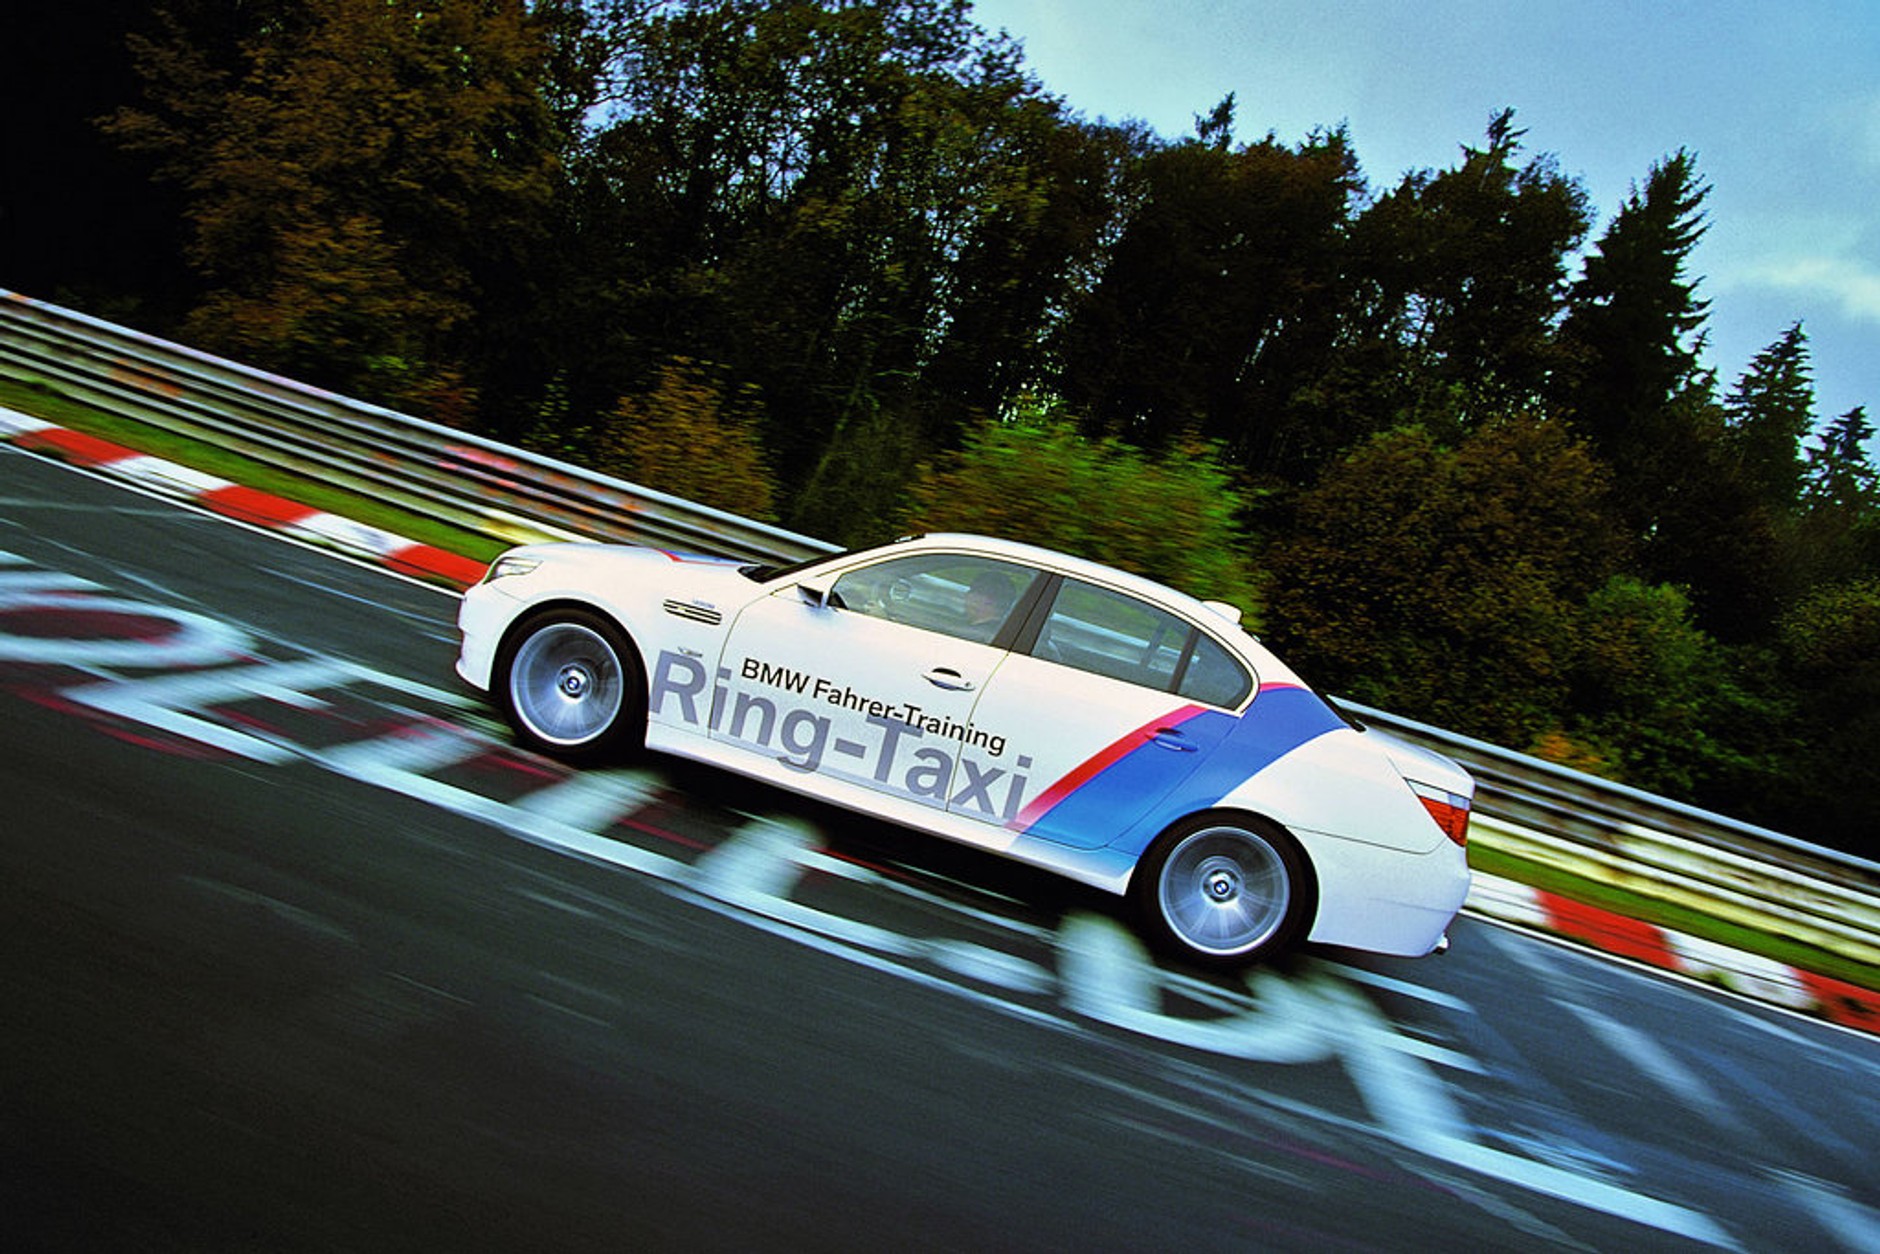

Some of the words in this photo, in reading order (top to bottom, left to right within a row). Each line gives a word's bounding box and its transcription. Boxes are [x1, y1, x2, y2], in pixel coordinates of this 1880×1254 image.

[651, 649, 1033, 821] Ring-Taxi
[741, 657, 810, 694] BMW
[812, 679, 1006, 757] Fahrer-Training
